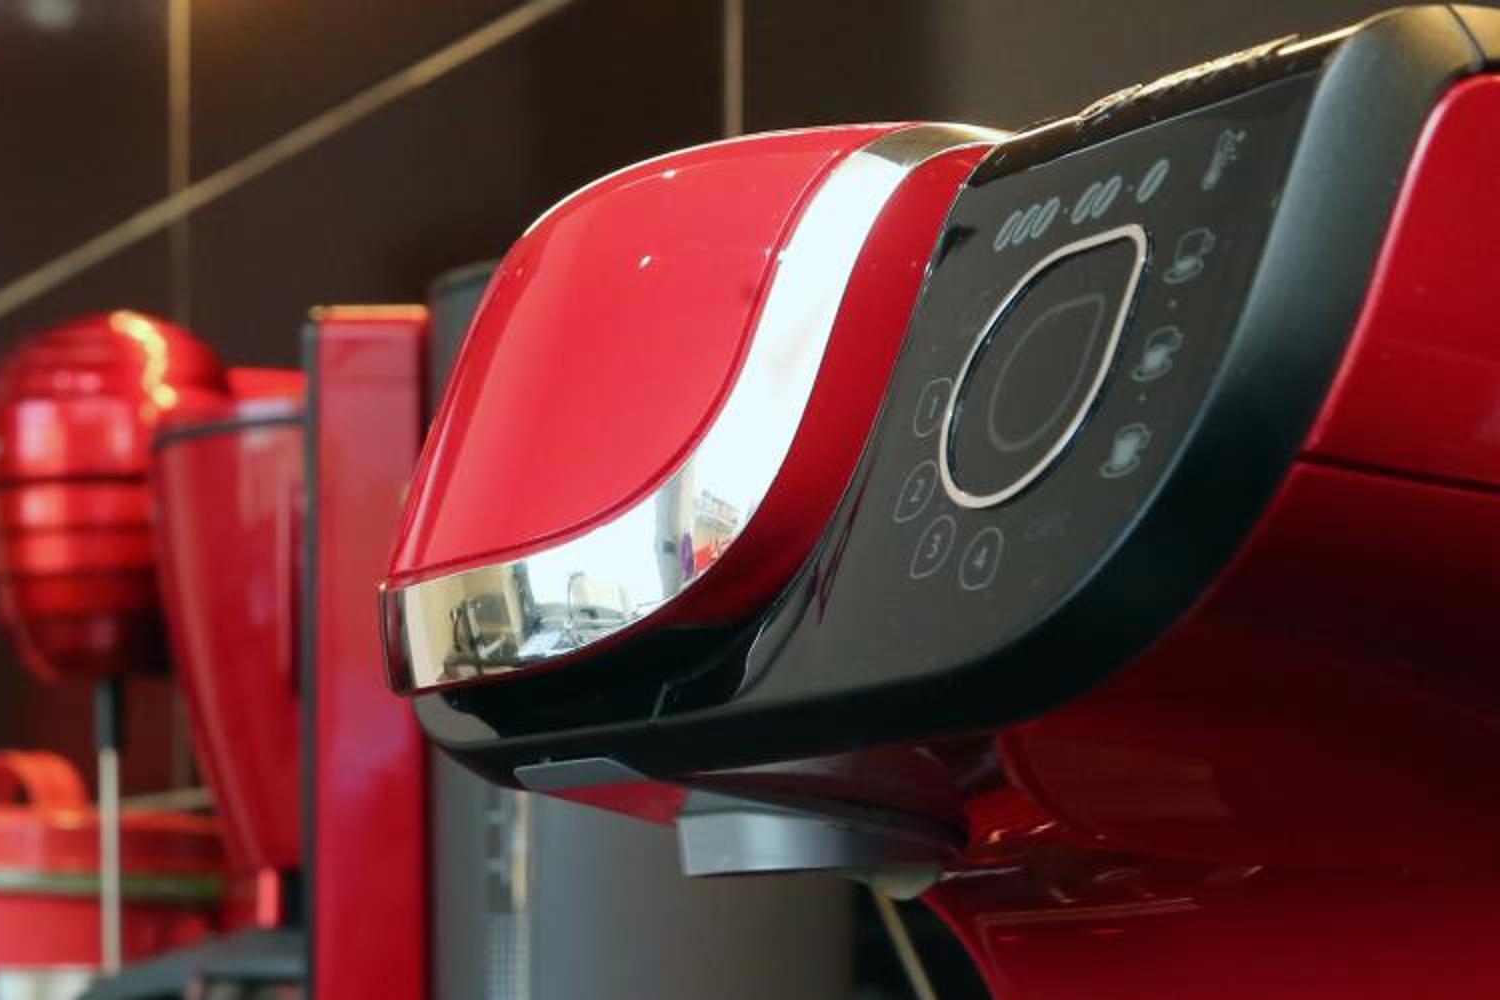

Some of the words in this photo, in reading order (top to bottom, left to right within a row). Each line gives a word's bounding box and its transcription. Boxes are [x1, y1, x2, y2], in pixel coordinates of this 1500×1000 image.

[909, 479, 925, 503] 2
[926, 534, 942, 559] 3
[972, 546, 988, 570] 4
